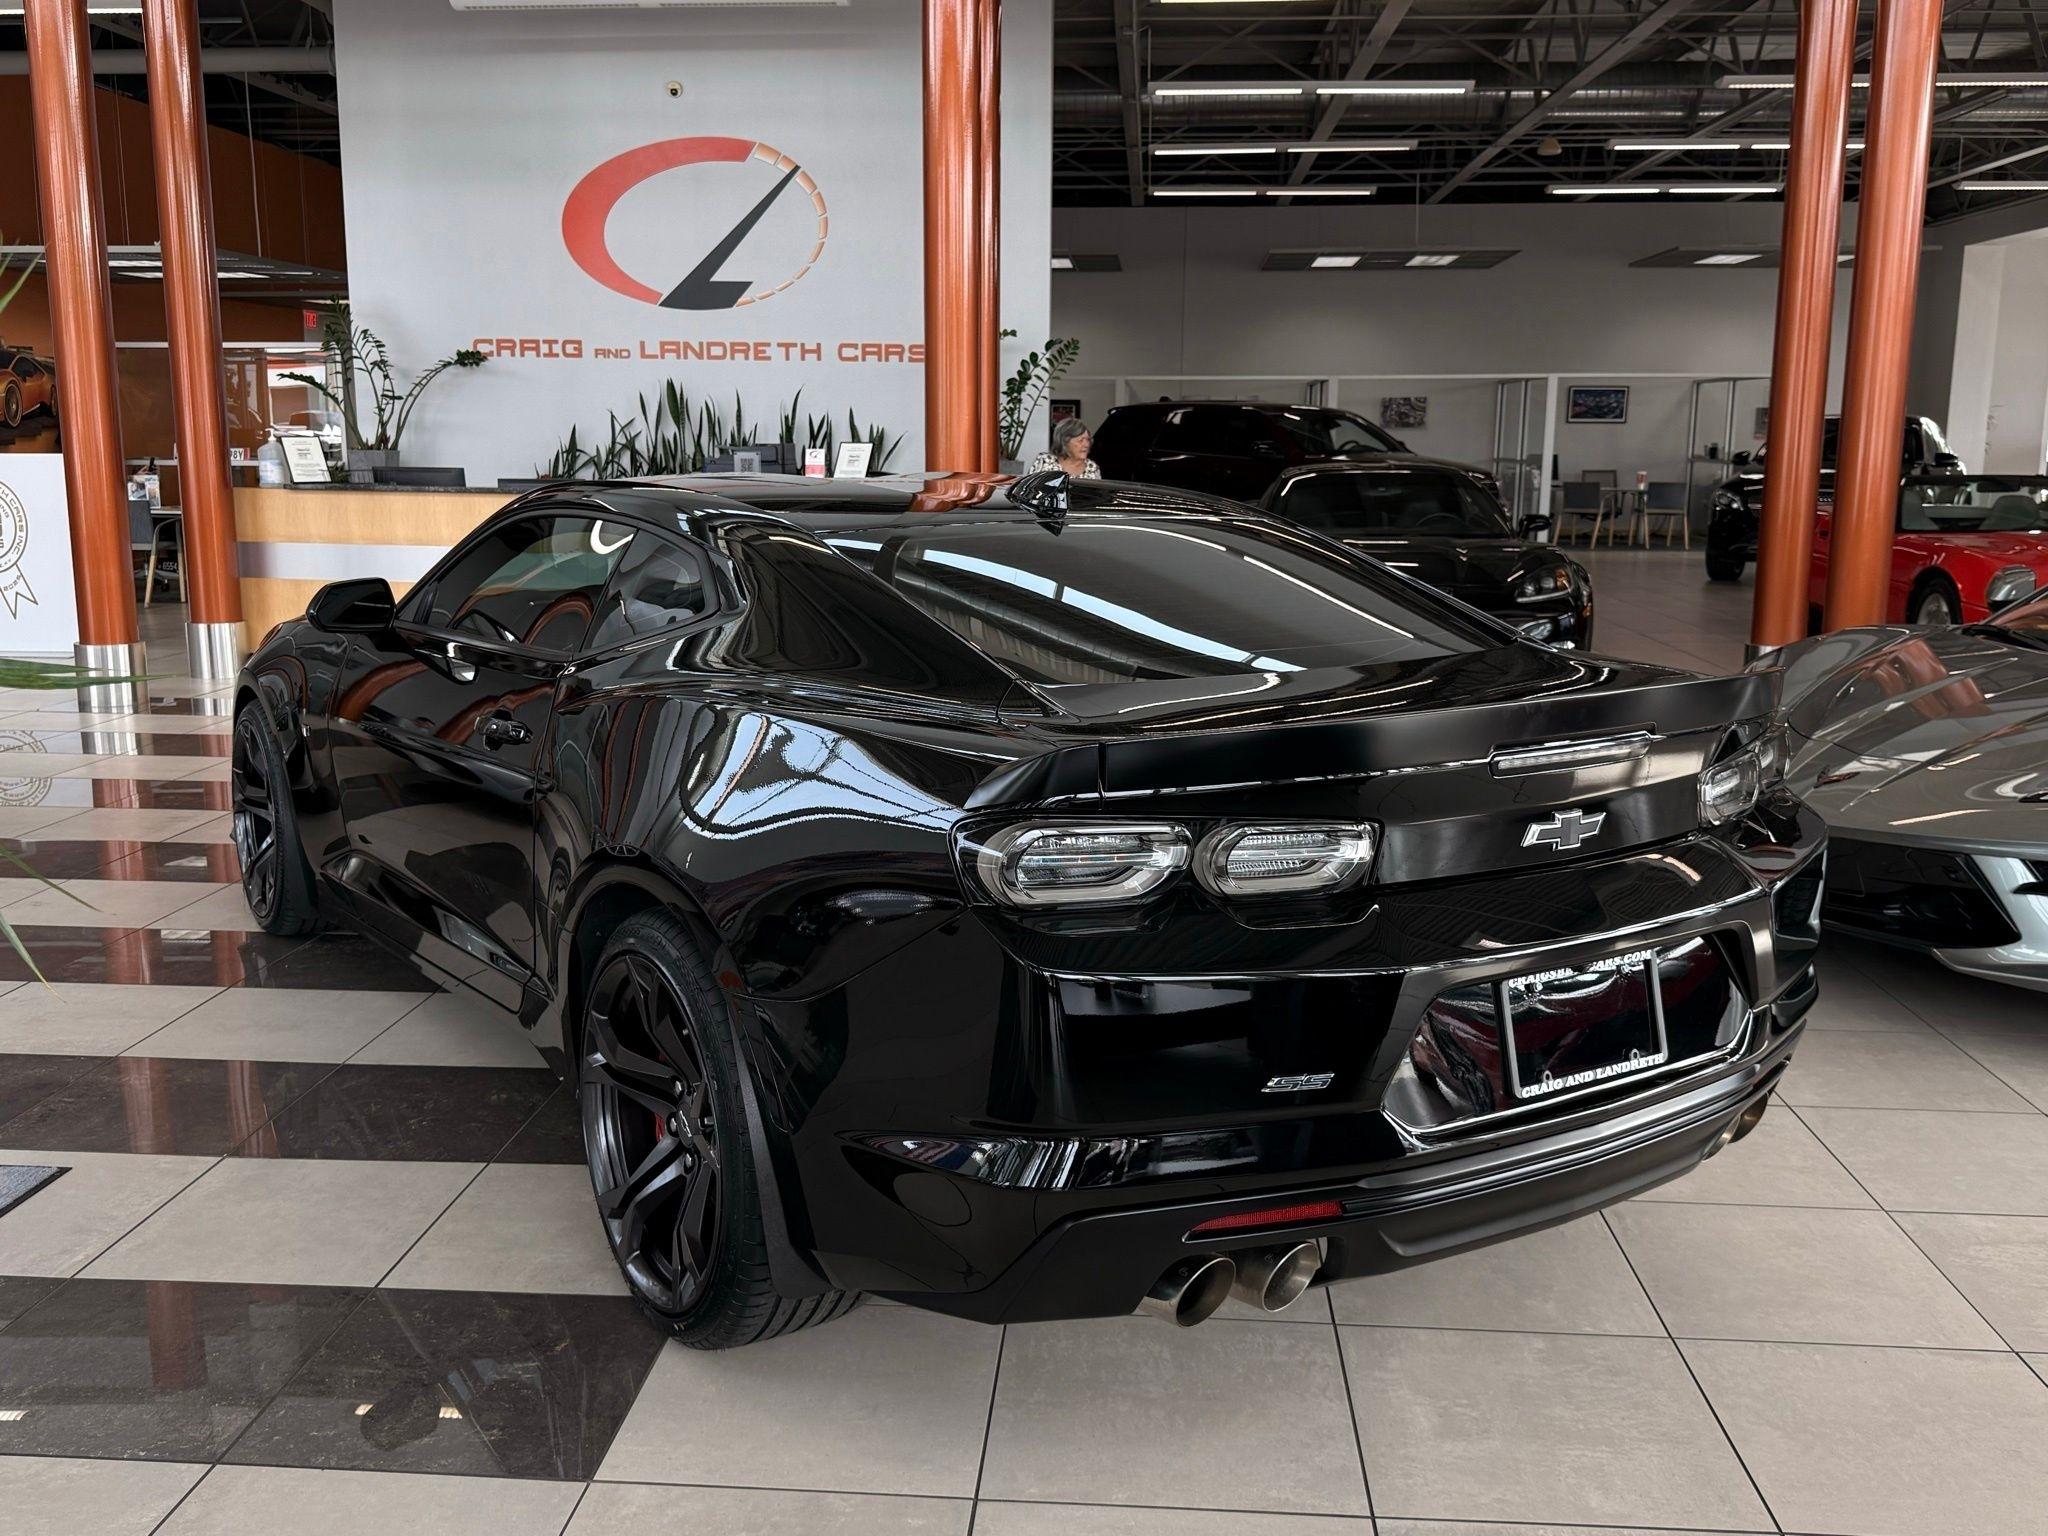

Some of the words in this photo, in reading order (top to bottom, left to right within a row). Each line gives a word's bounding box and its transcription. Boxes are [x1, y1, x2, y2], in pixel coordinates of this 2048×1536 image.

[473, 338, 584, 358] CRAIG
[594, 348, 631, 360] AND
[639, 341, 822, 362] LANDRETH
[837, 342, 925, 363] CARS
[1521, 1076, 1564, 1098] CRAIG
[1565, 1070, 1595, 1088] AND
[1596, 1053, 1664, 1079] LANDRETH
